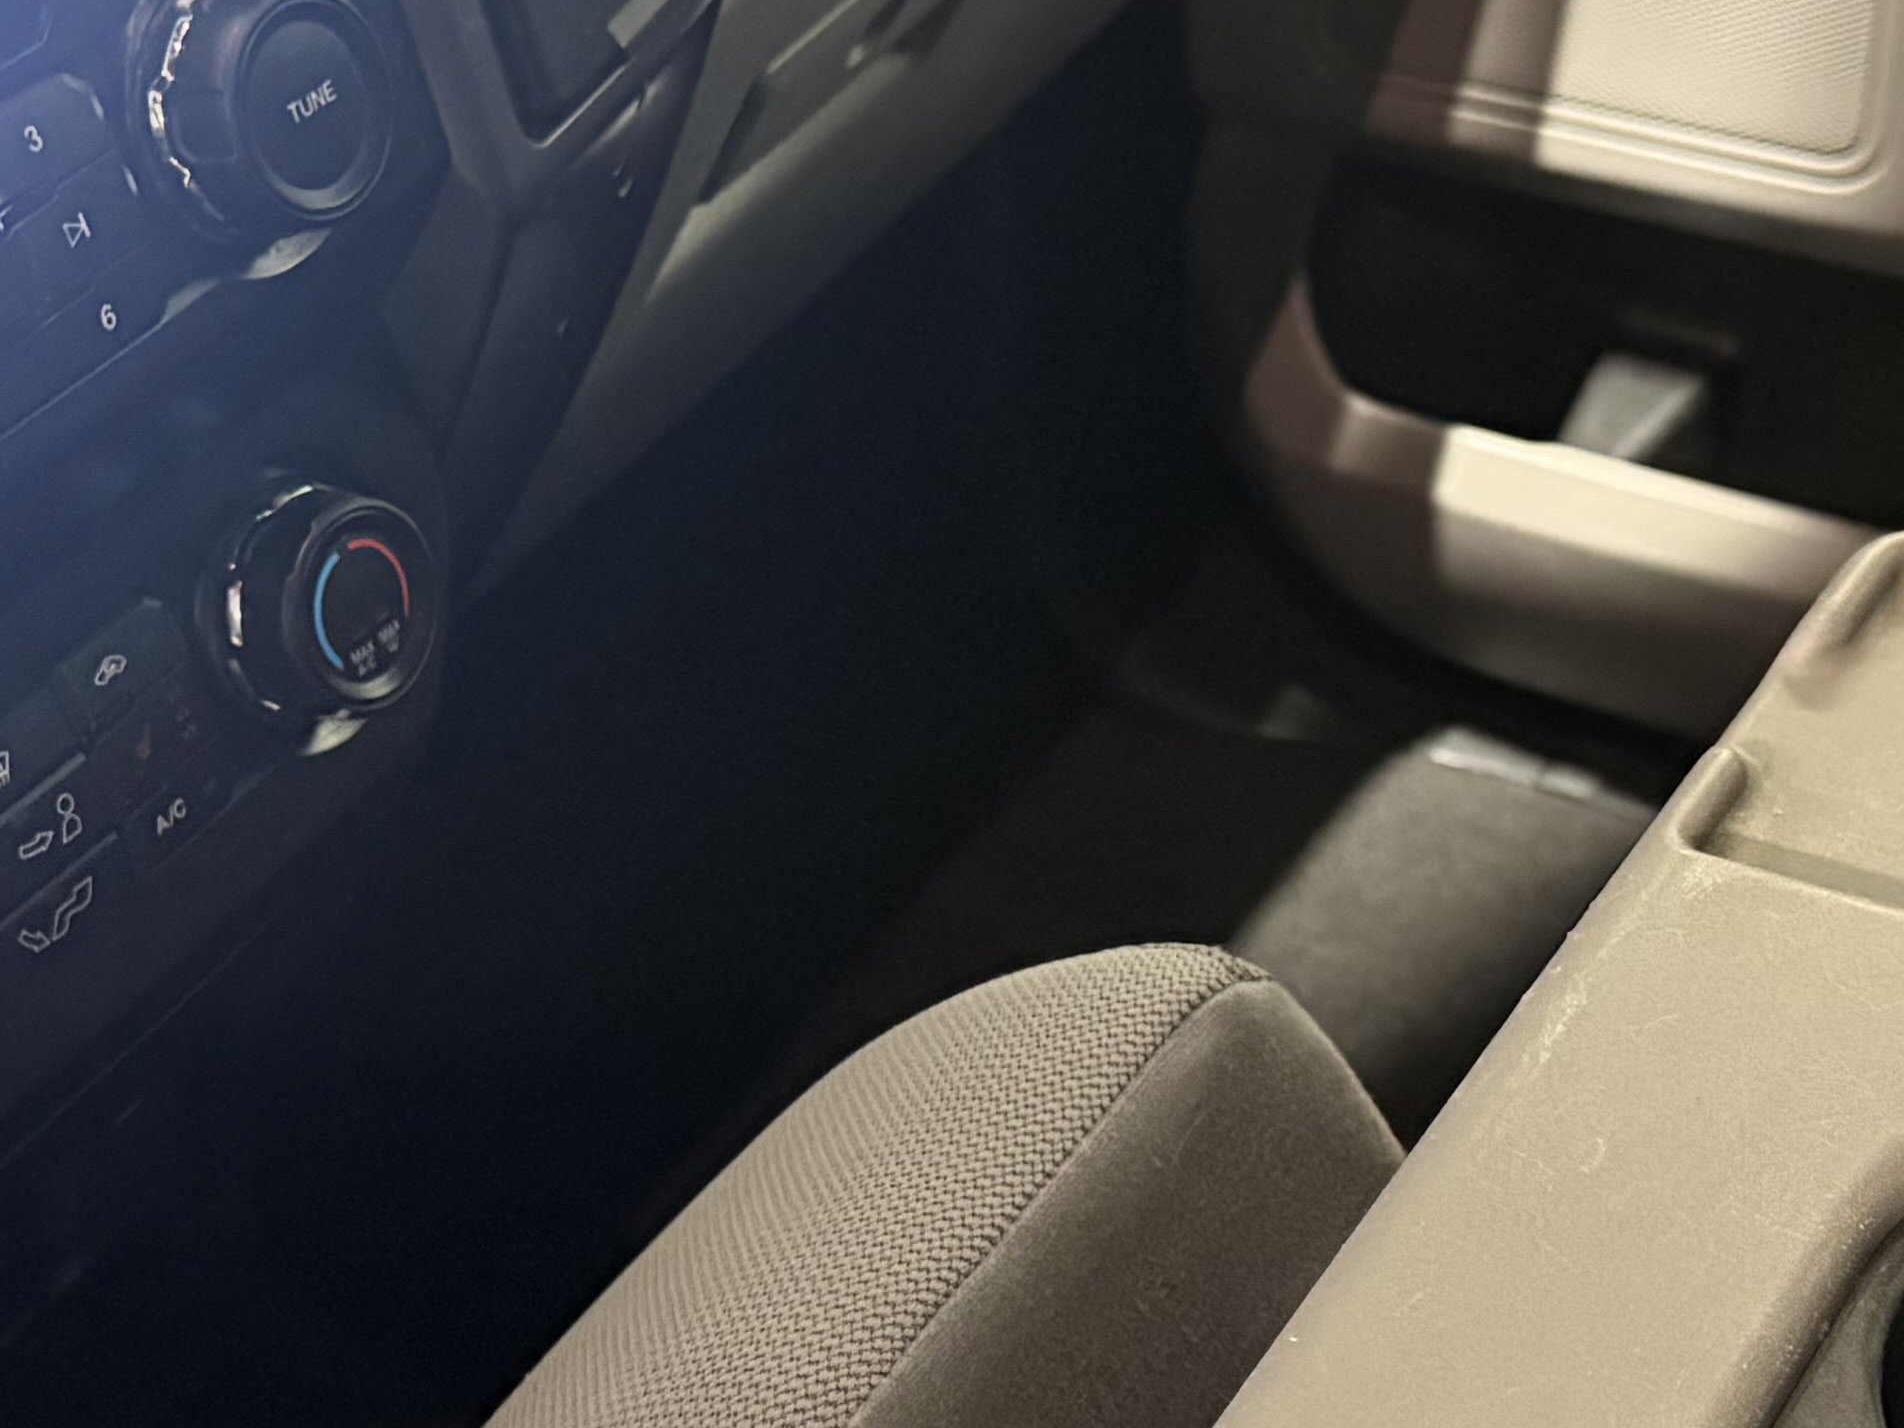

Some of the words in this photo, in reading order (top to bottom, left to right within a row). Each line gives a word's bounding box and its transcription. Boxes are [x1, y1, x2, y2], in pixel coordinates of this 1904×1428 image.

[286, 79, 339, 125] TUNE
[23, 124, 44, 154] 3
[100, 303, 118, 332] 6
[156, 798, 187, 835] A/C
